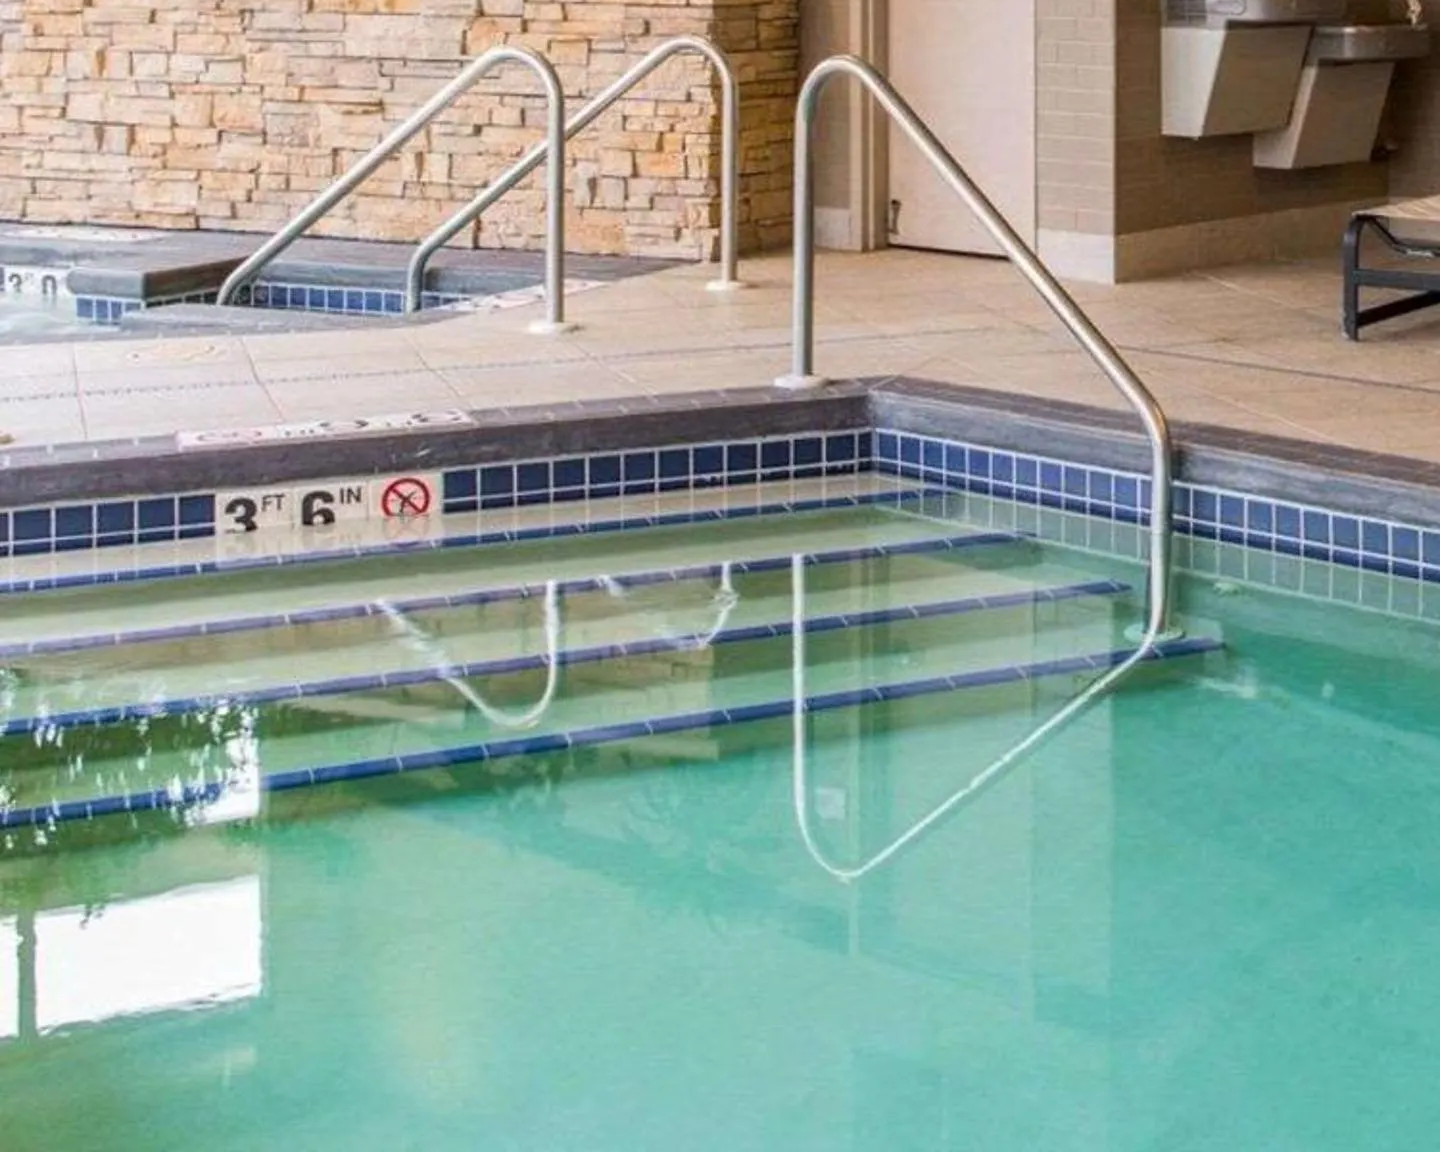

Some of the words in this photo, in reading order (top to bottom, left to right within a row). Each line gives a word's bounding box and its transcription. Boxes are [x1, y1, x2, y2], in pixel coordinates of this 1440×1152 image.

[225, 497, 258, 533] 3
[261, 494, 286, 511] FT
[302, 490, 335, 526] 6
[340, 486, 362, 504] IN
